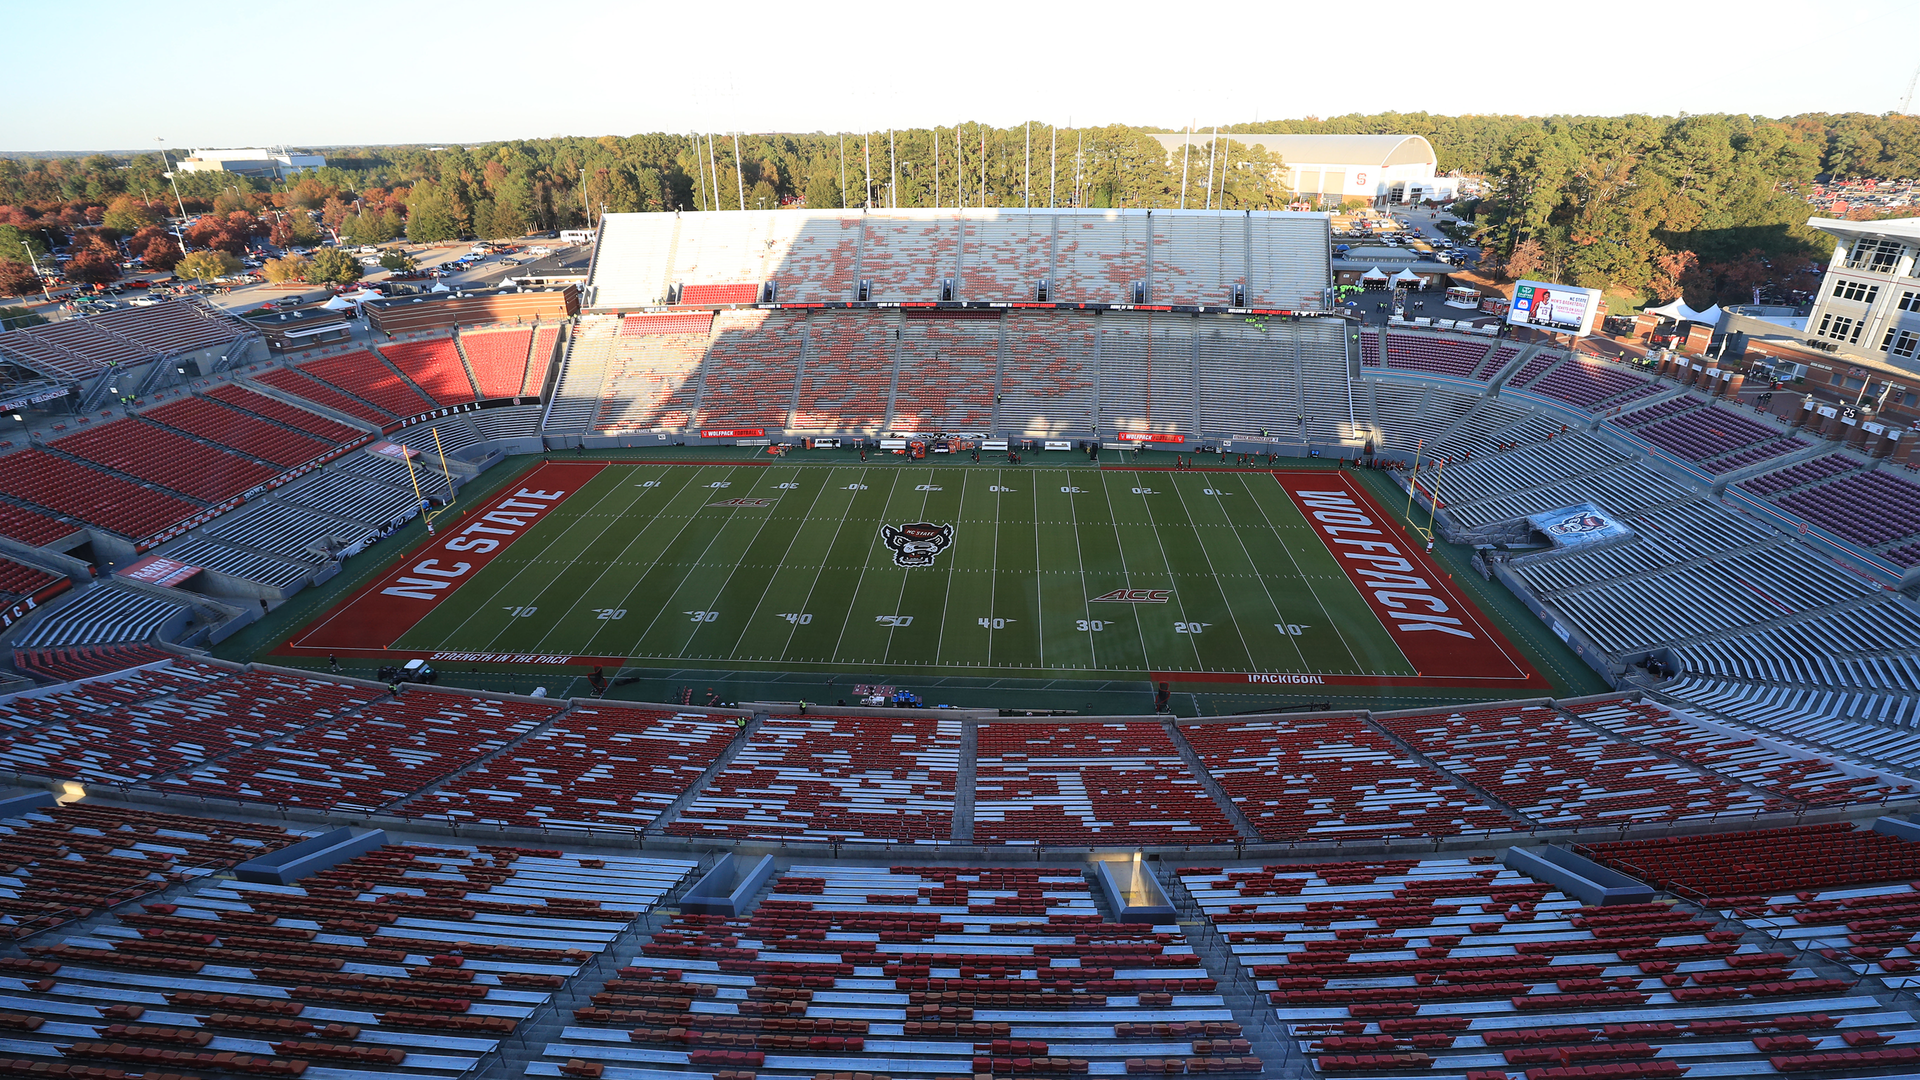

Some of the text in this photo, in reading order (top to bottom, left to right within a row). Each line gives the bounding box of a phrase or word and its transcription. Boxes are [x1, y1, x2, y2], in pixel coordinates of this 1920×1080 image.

[30, 388, 71, 405] FIELDHOUSE
[401, 402, 482, 428] FOOTBALL
[1843, 407, 1856, 418] 25
[243, 485, 267, 499] BOWL
[779, 482, 800, 490] 30
[1203, 488, 1223, 496] 10
[380, 487, 565, 600] NC STATE
[1296, 490, 1477, 640] WOLFPACK
[1092, 588, 1173, 602] ACC
[511, 606, 538, 618] 10
[596, 608, 628, 620] 20
[690, 611, 720, 622] 30
[785, 613, 814, 625] 40
[978, 617, 1005, 629] 40
[1075, 619, 1104, 632] 30
[1174, 621, 1203, 634] 20
[1274, 623, 1303, 636] 10
[430, 652, 572, 665] STRENGTH IN THE PACK
